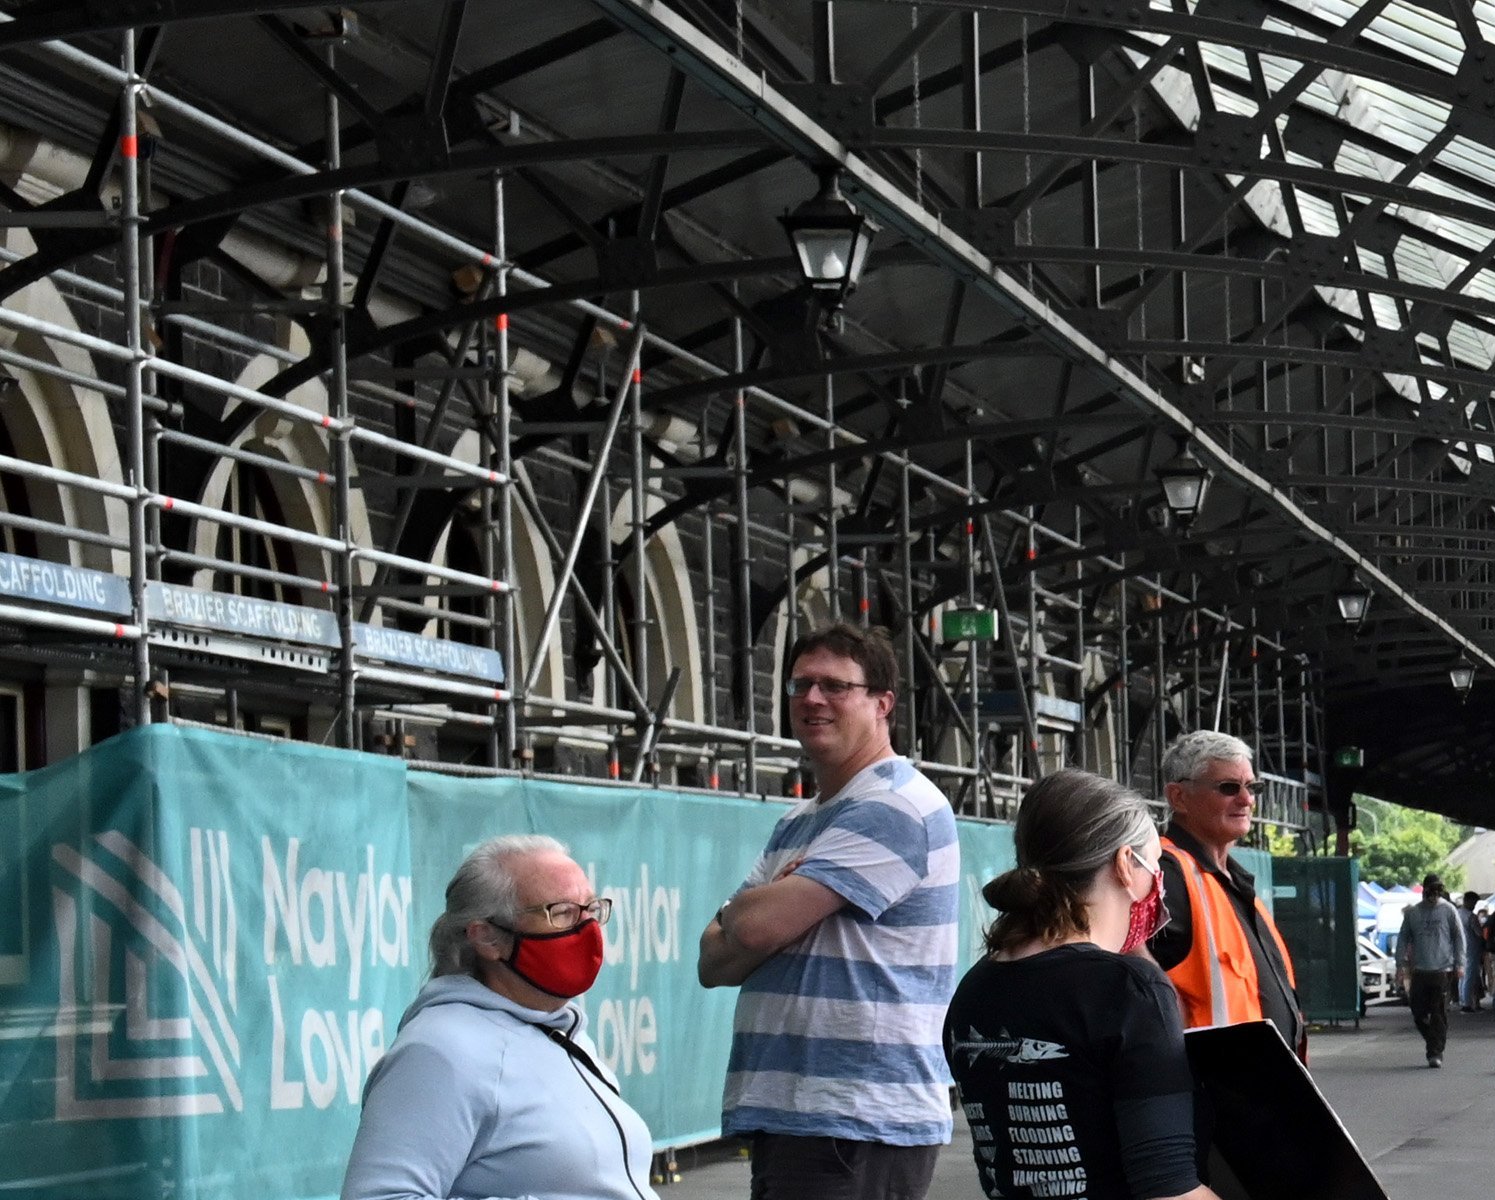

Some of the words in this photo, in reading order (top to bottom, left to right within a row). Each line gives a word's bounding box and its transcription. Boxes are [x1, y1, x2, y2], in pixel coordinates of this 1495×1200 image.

[162, 587, 225, 623] BRAZIER
[228, 599, 322, 640] SCAFFOLDING
[365, 627, 413, 659] BRAZIER
[415, 636, 489, 675] SCAFFOLDING
[262, 835, 413, 1000] Naylor
[268, 974, 385, 1110] Love
[580, 991, 657, 1076] ove
[1008, 1081, 1064, 1101] MELTING
[1008, 1103, 1069, 1123] BURNING
[1008, 1125, 1076, 1144] FLOODING
[1012, 1146, 1082, 1166] STARVING
[1012, 1167, 1087, 1187] VANISHING
